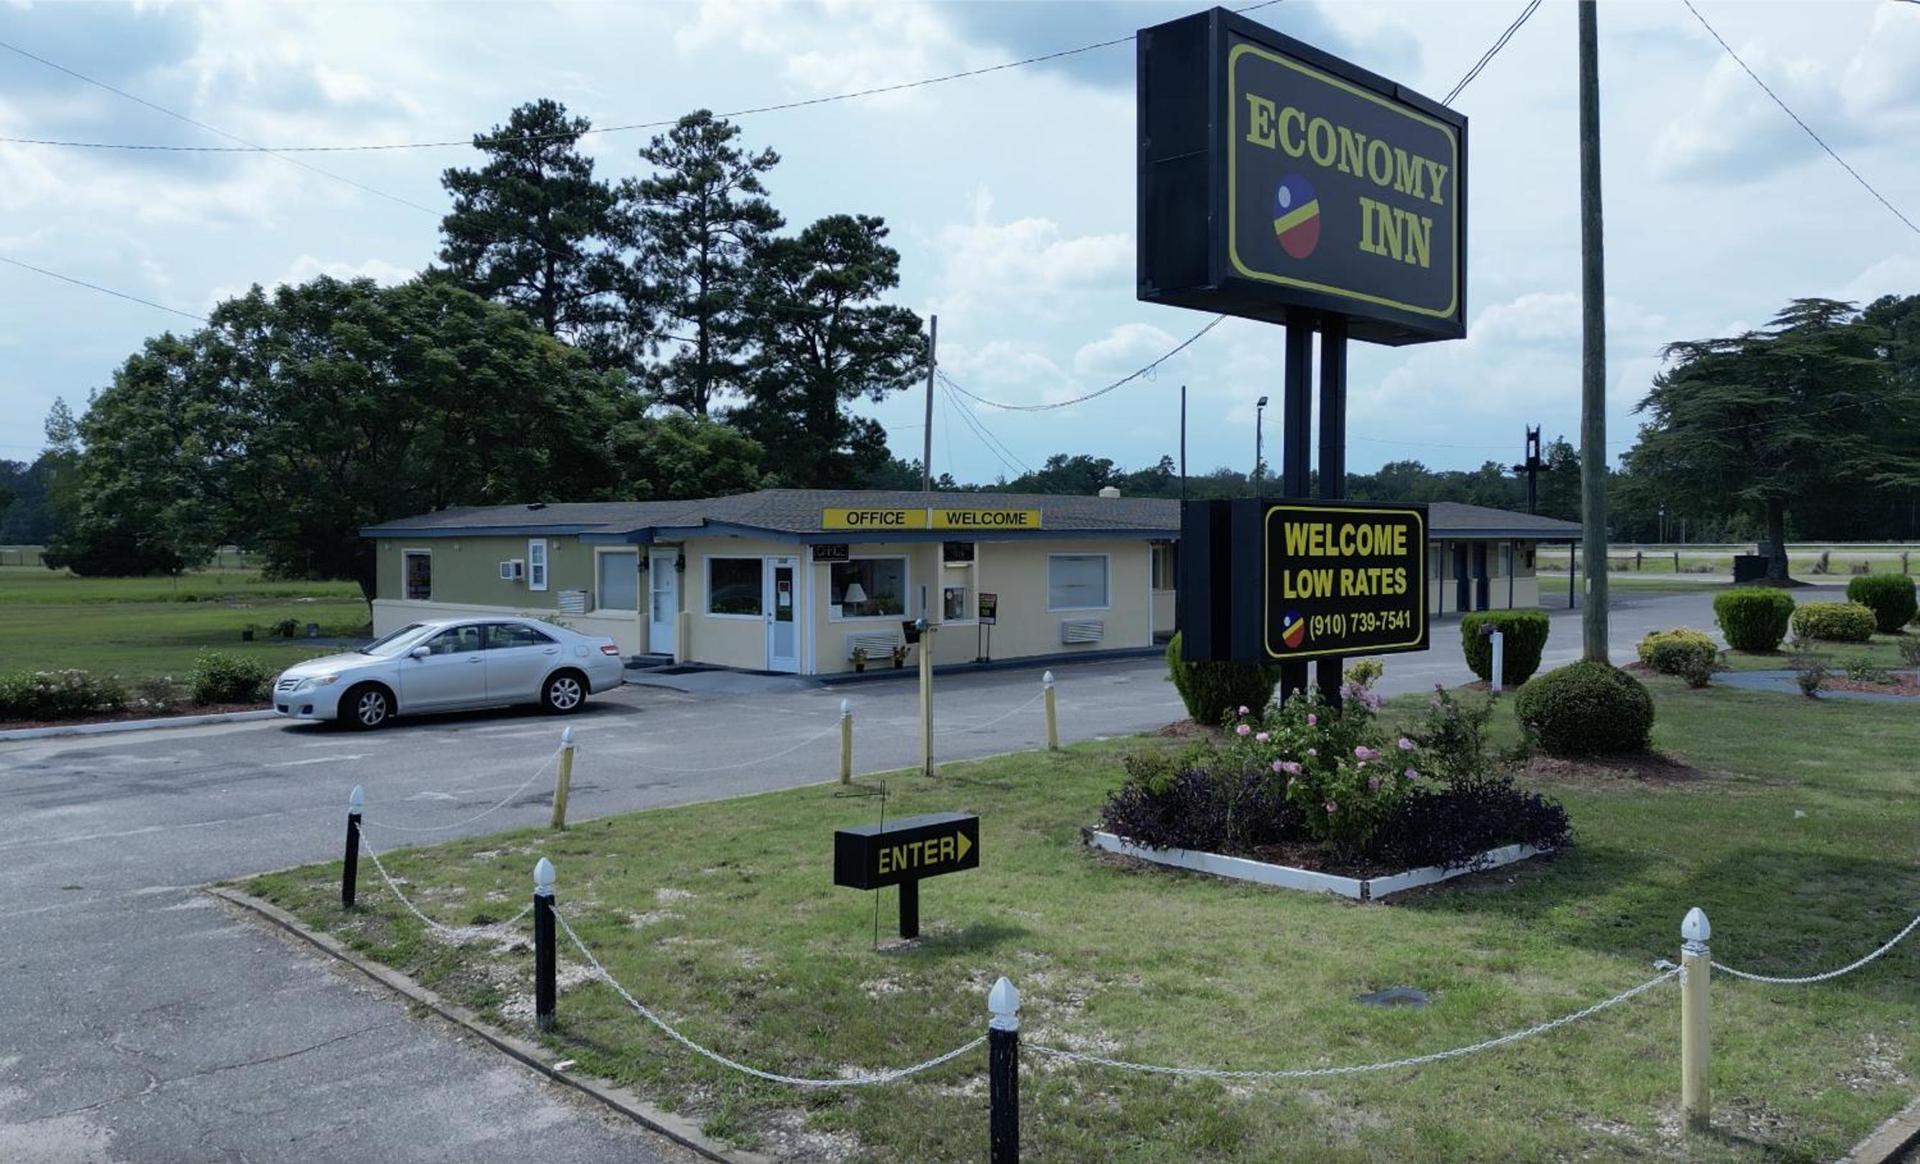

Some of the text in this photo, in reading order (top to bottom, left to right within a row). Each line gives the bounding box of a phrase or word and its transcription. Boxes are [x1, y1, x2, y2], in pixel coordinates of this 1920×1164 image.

[1246, 92, 1448, 206] ECONOMY
[1359, 196, 1433, 269] INN
[846, 511, 906, 525] OFFICE
[946, 511, 1027, 525] WELCOME
[1284, 522, 1408, 556] WELCOME
[1283, 567, 1408, 599] LOW RATES
[1309, 610, 1411, 641] (910) 739-7541
[878, 836, 955, 874] ENTER
